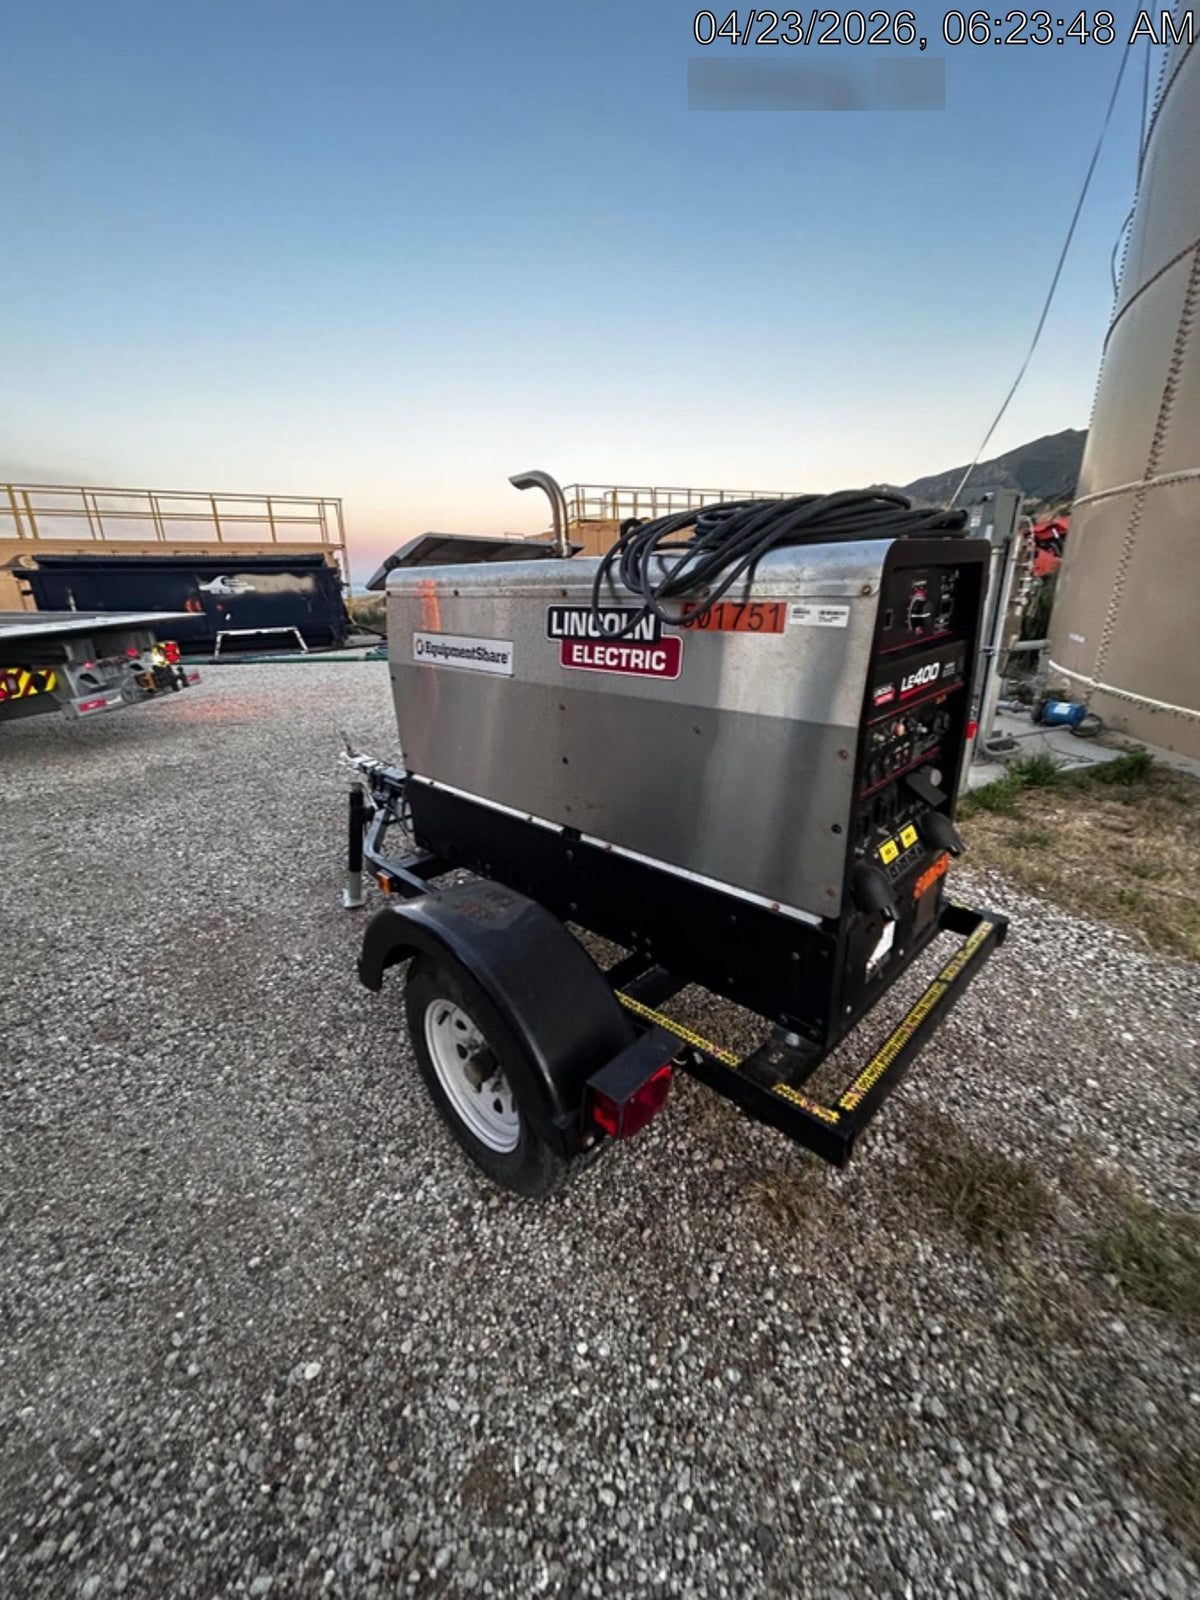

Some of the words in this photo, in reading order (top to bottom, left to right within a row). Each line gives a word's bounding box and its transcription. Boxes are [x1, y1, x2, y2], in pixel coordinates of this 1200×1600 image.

[551, 610, 656, 641] LINCOLN
[425, 641, 509, 665] EquipmentShare
[572, 644, 667, 671] ELECTRIC
